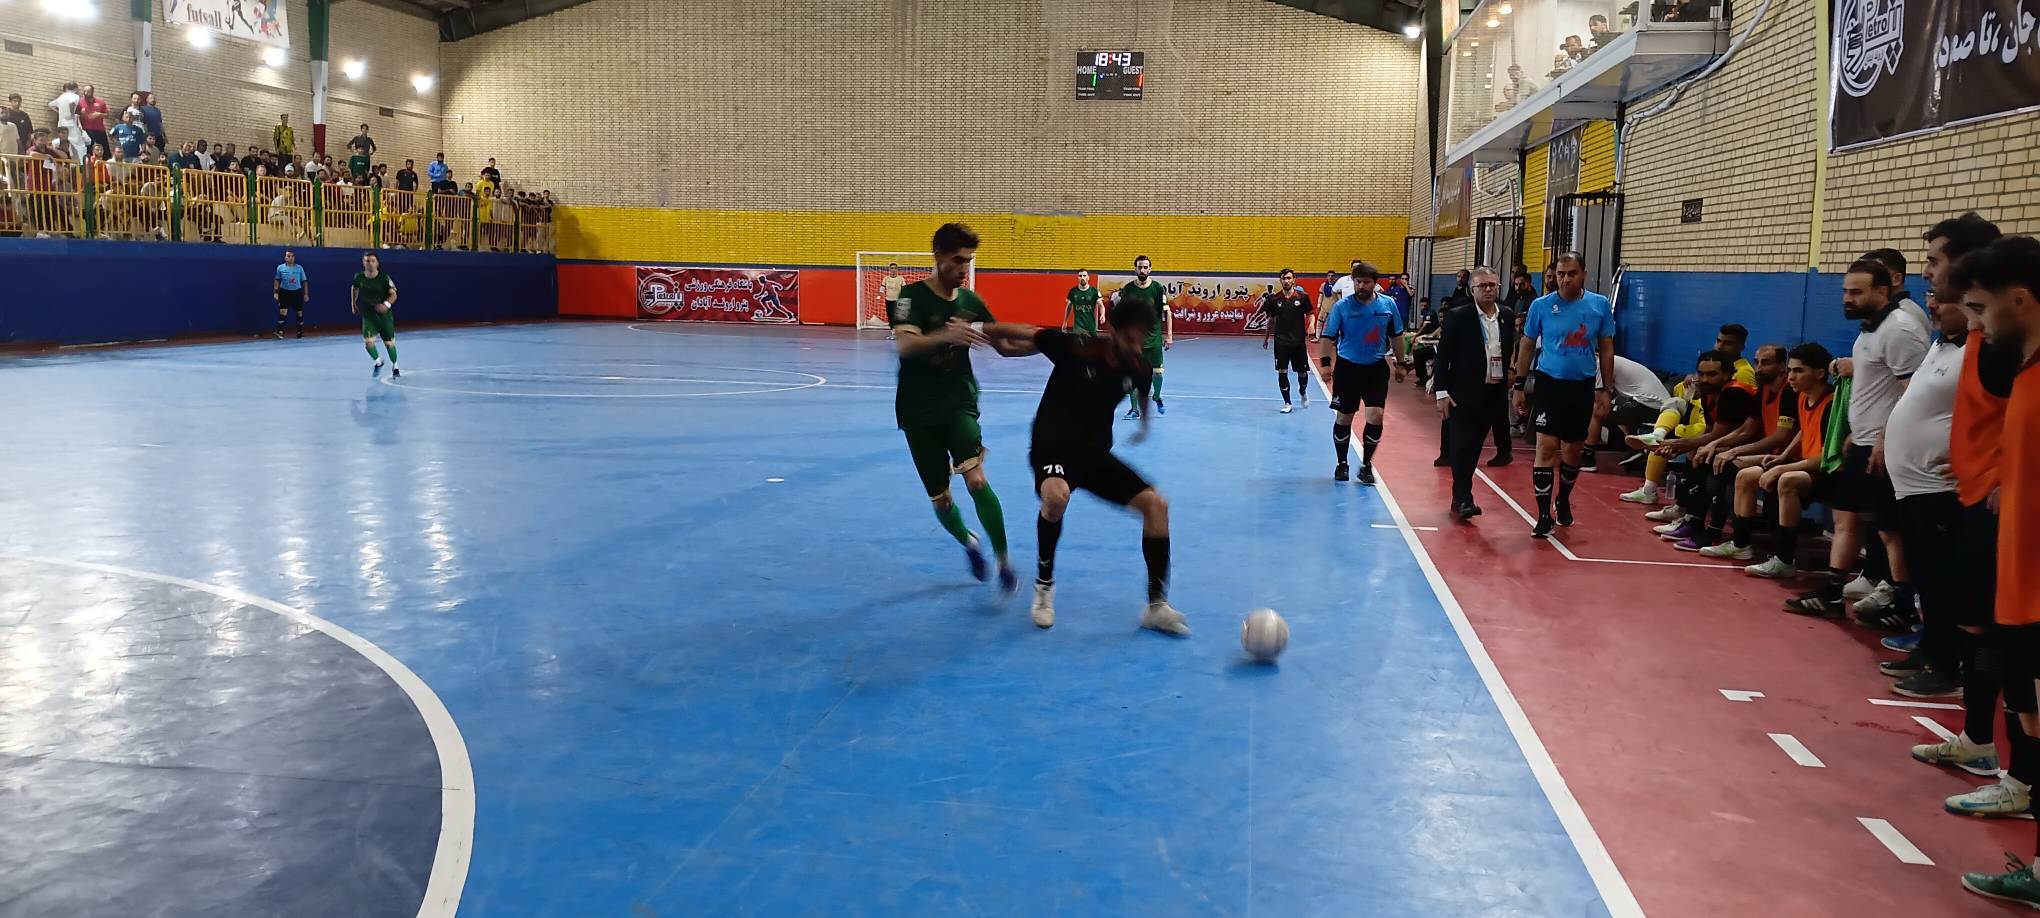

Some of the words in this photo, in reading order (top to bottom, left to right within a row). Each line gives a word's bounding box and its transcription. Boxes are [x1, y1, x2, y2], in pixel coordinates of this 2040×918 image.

[1095, 52, 1131, 66] 18:43
[1077, 66, 1097, 74] HOME
[1123, 66, 1143, 74] GUEST
[685, 278, 708, 292] ورزشی
[709, 278, 733, 292] فرهنگی
[733, 278, 753, 292] باشگاه
[1188, 283, 1221, 299] اروند
[1224, 285, 1249, 301] پترو
